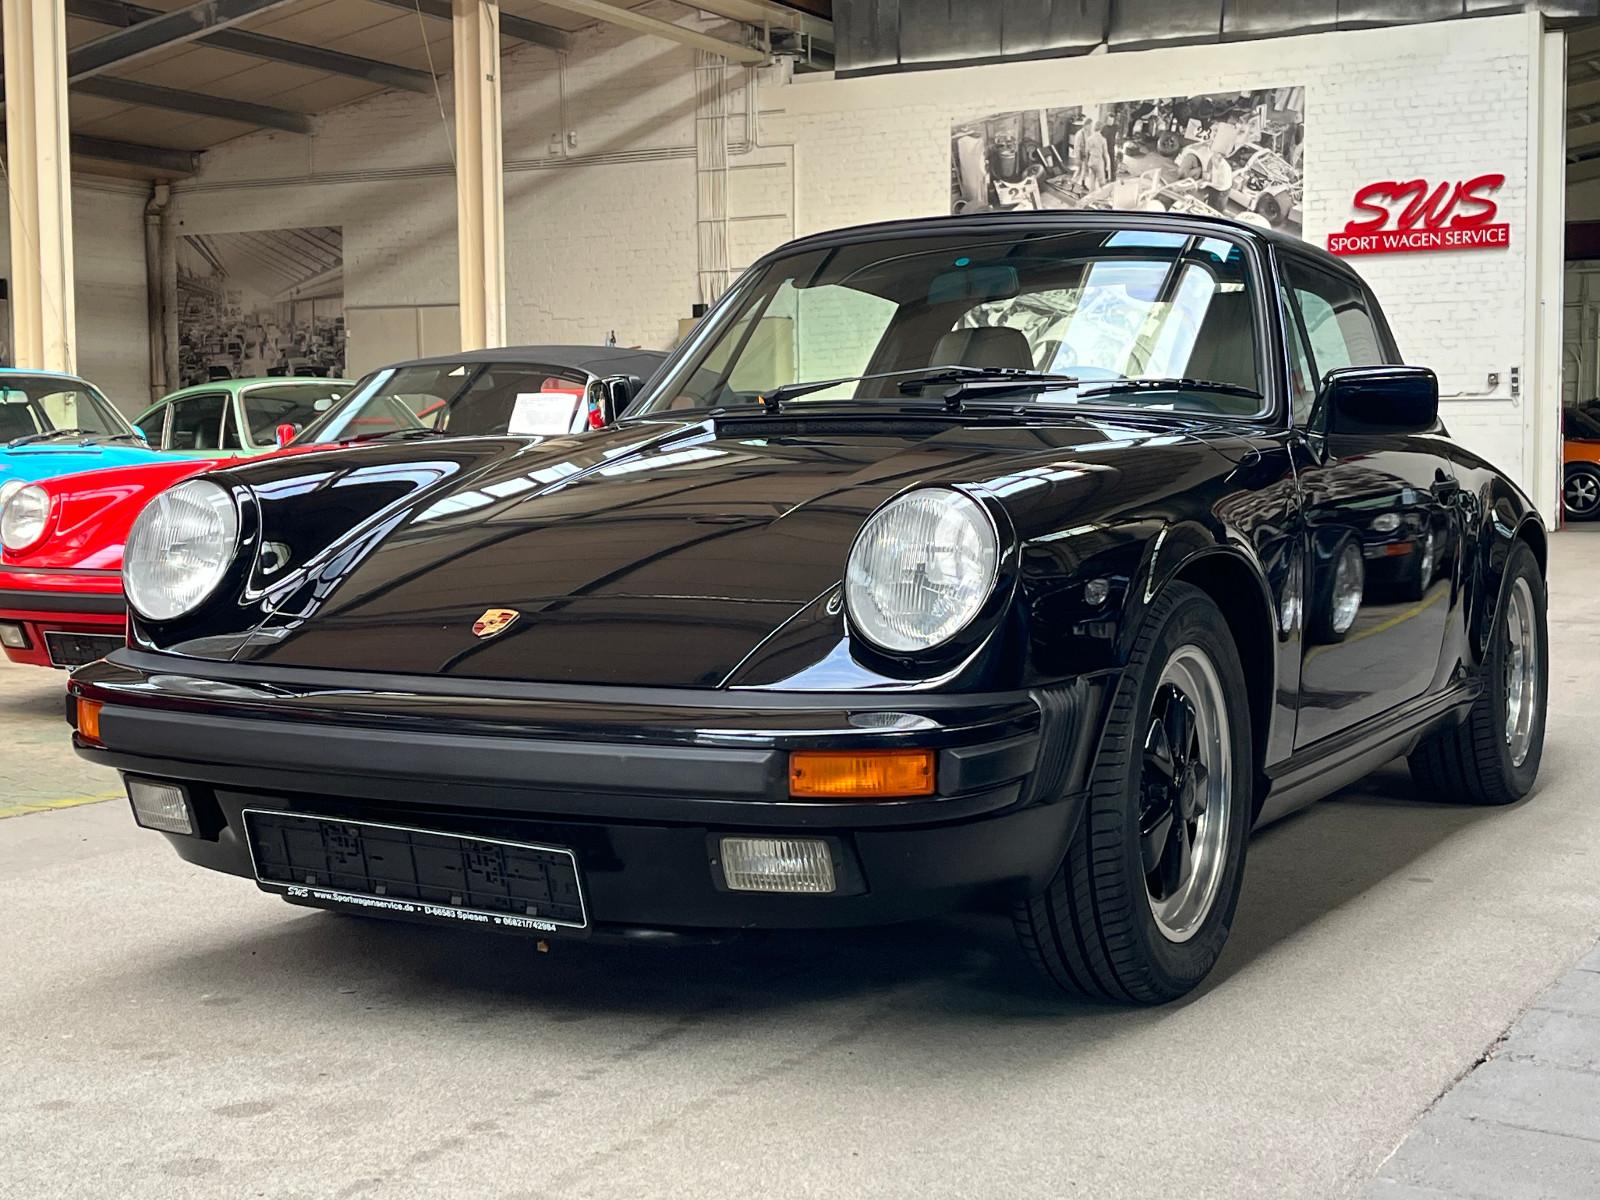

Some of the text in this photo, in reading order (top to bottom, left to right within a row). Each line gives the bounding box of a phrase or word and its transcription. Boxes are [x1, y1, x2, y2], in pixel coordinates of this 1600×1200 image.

[1195, 126, 1212, 140] 23
[1344, 174, 1505, 231] SWS
[1330, 228, 1506, 252] SPORT WAGEN SERVICE
[287, 886, 309, 897] SWS
